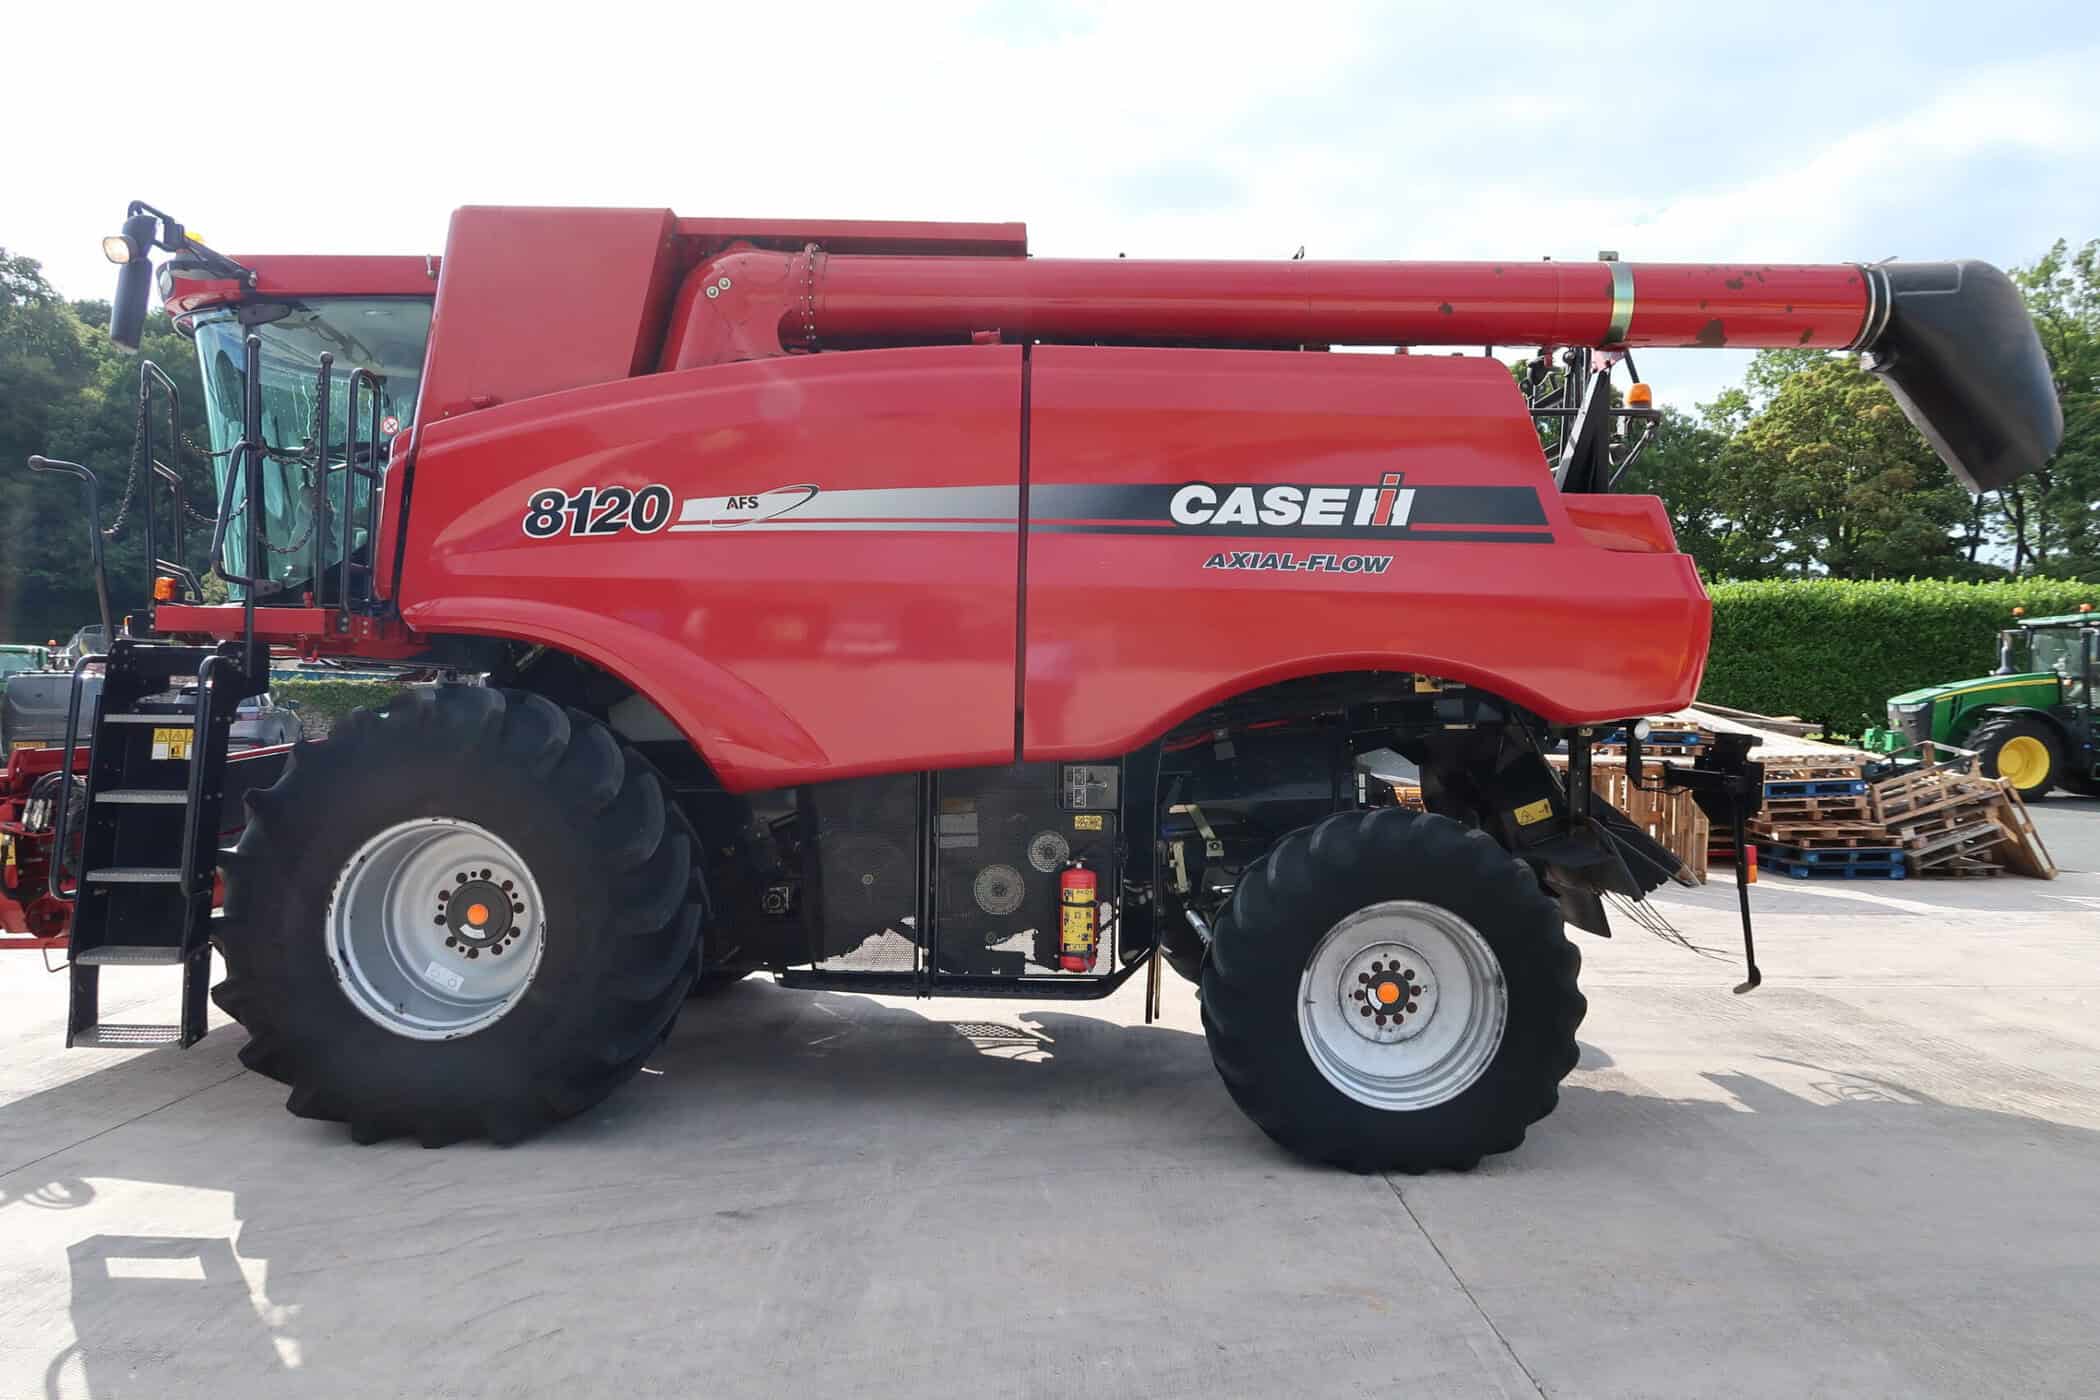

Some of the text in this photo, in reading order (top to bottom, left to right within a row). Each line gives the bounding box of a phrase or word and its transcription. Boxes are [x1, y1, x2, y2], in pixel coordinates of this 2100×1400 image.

[523, 483, 673, 538] 8120
[726, 496, 759, 510] AFS
[1170, 484, 1350, 526] CASE
[1203, 551, 1393, 574] AXIAL-FLOW
